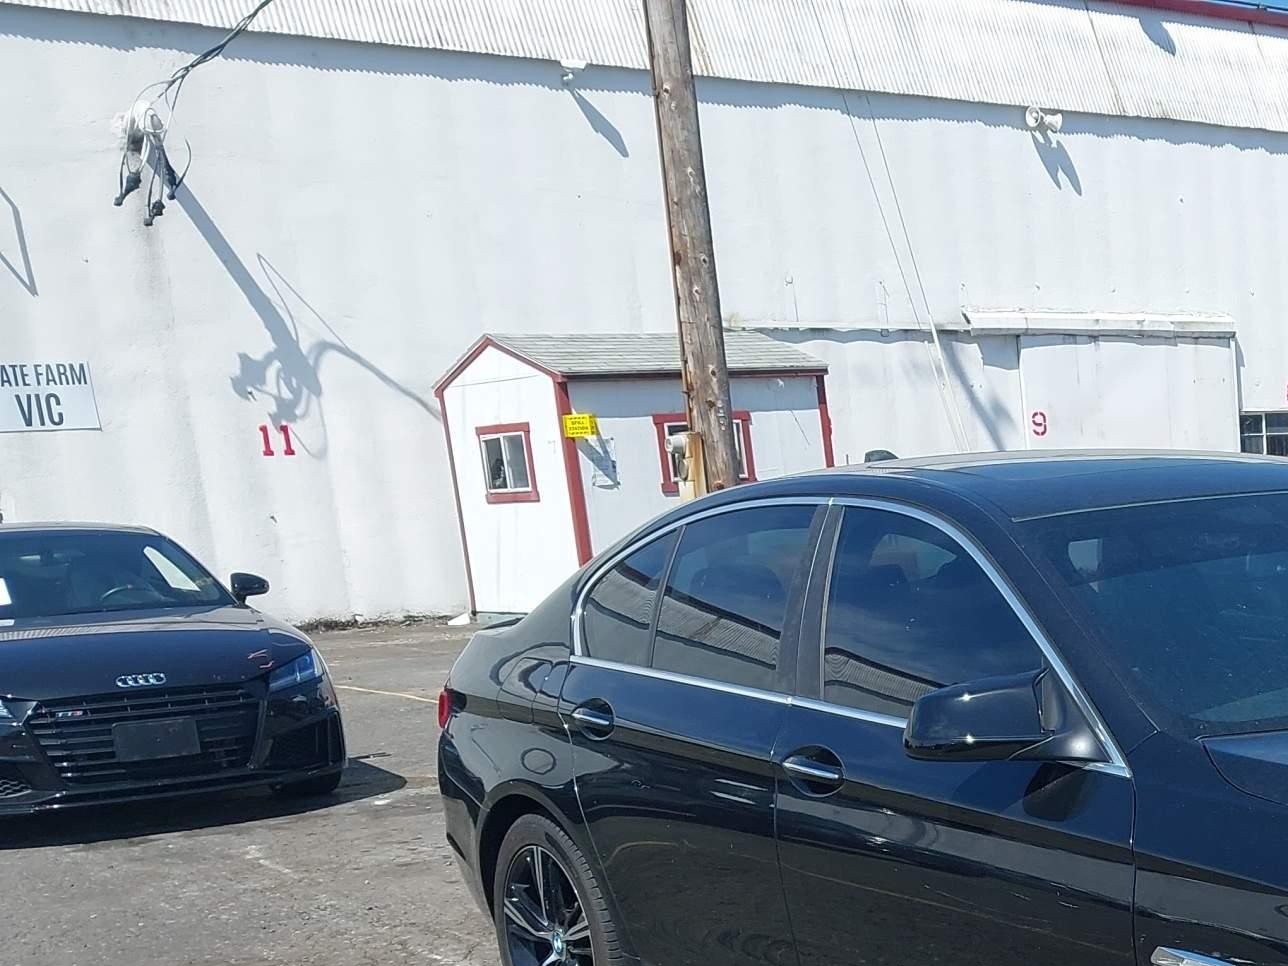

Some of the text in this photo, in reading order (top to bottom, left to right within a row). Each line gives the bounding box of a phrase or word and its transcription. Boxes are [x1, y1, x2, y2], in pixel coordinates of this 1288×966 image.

[0, 363, 88, 387] ATE FARM
[14, 392, 64, 427] VIC
[1032, 411, 1047, 436] 9
[258, 424, 296, 456] 11
